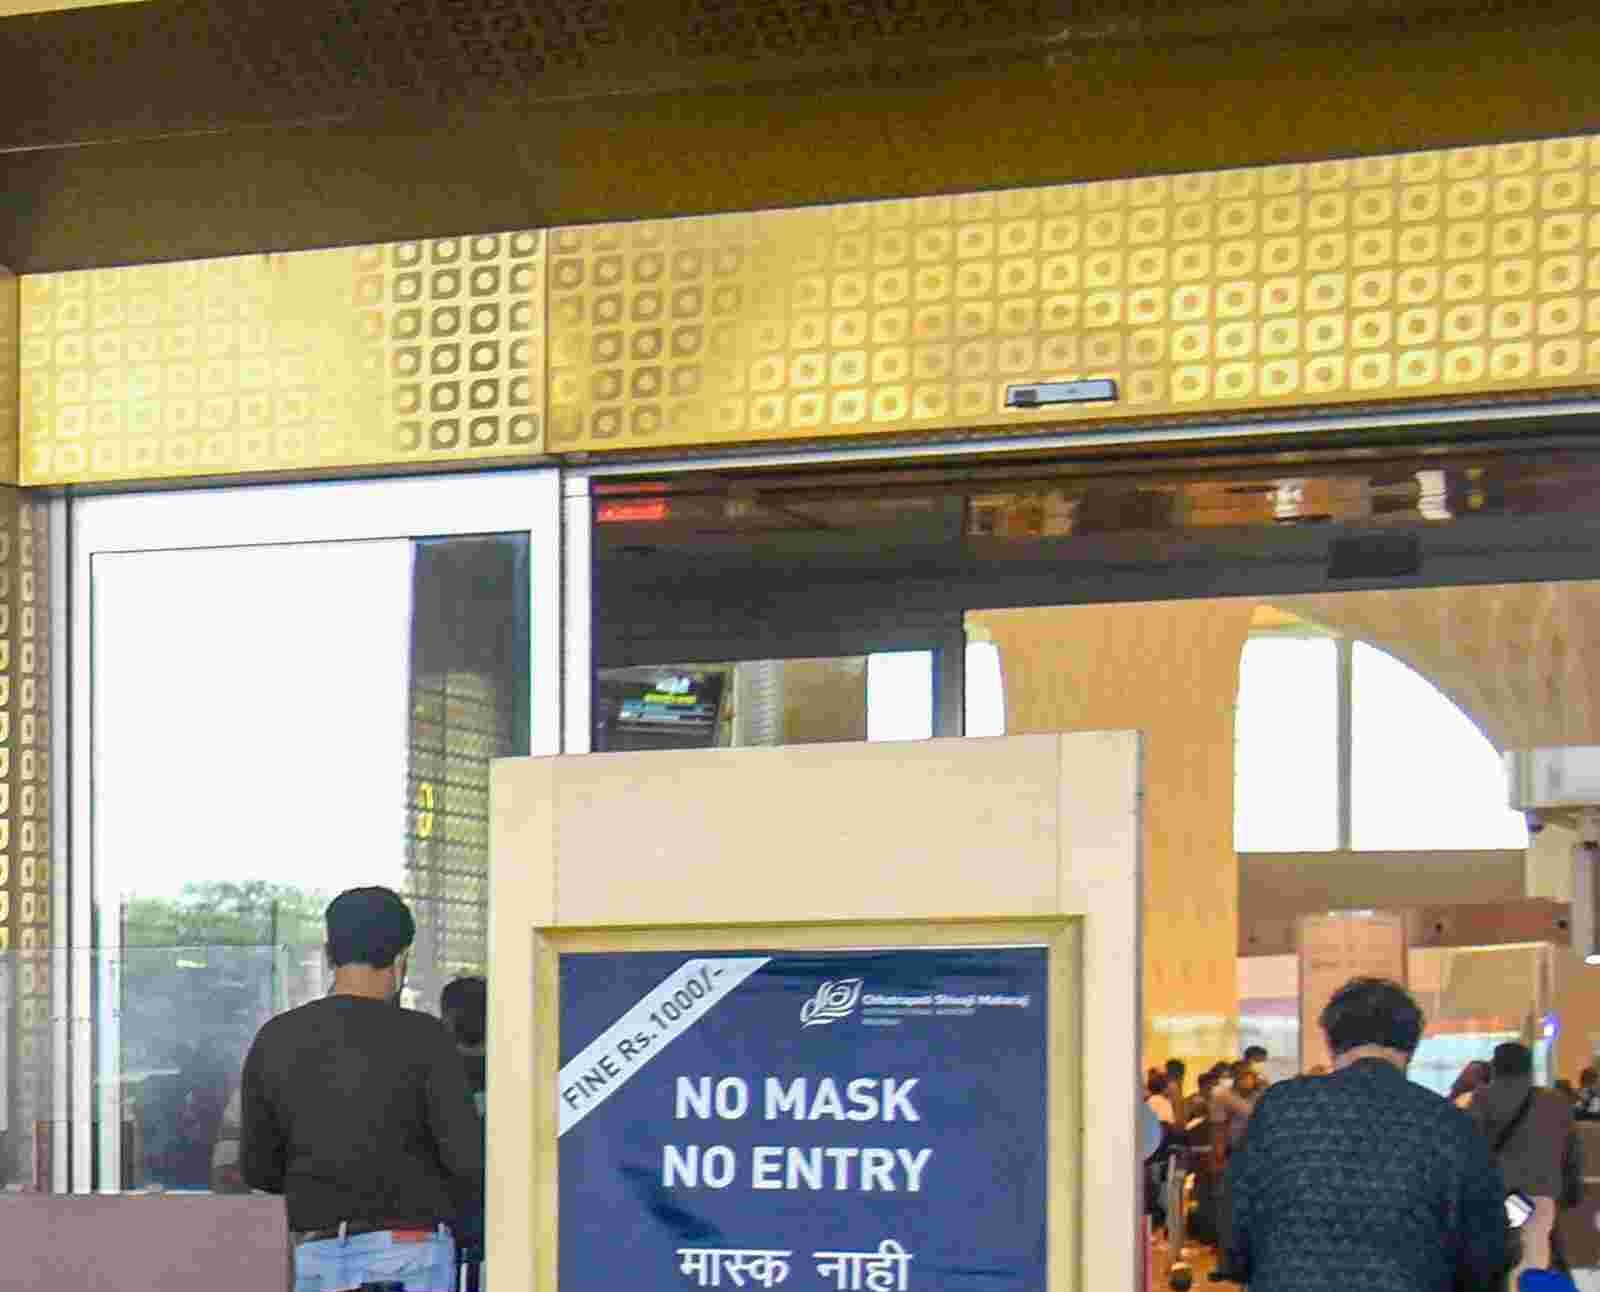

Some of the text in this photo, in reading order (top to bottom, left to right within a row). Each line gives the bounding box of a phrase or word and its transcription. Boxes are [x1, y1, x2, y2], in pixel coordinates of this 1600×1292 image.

[561, 1055, 622, 1110] FINE
[674, 1075, 921, 1122] NO MASK
[660, 1144, 934, 1192] NO ENTRY
[674, 1238, 914, 1292] मास्क नाही
